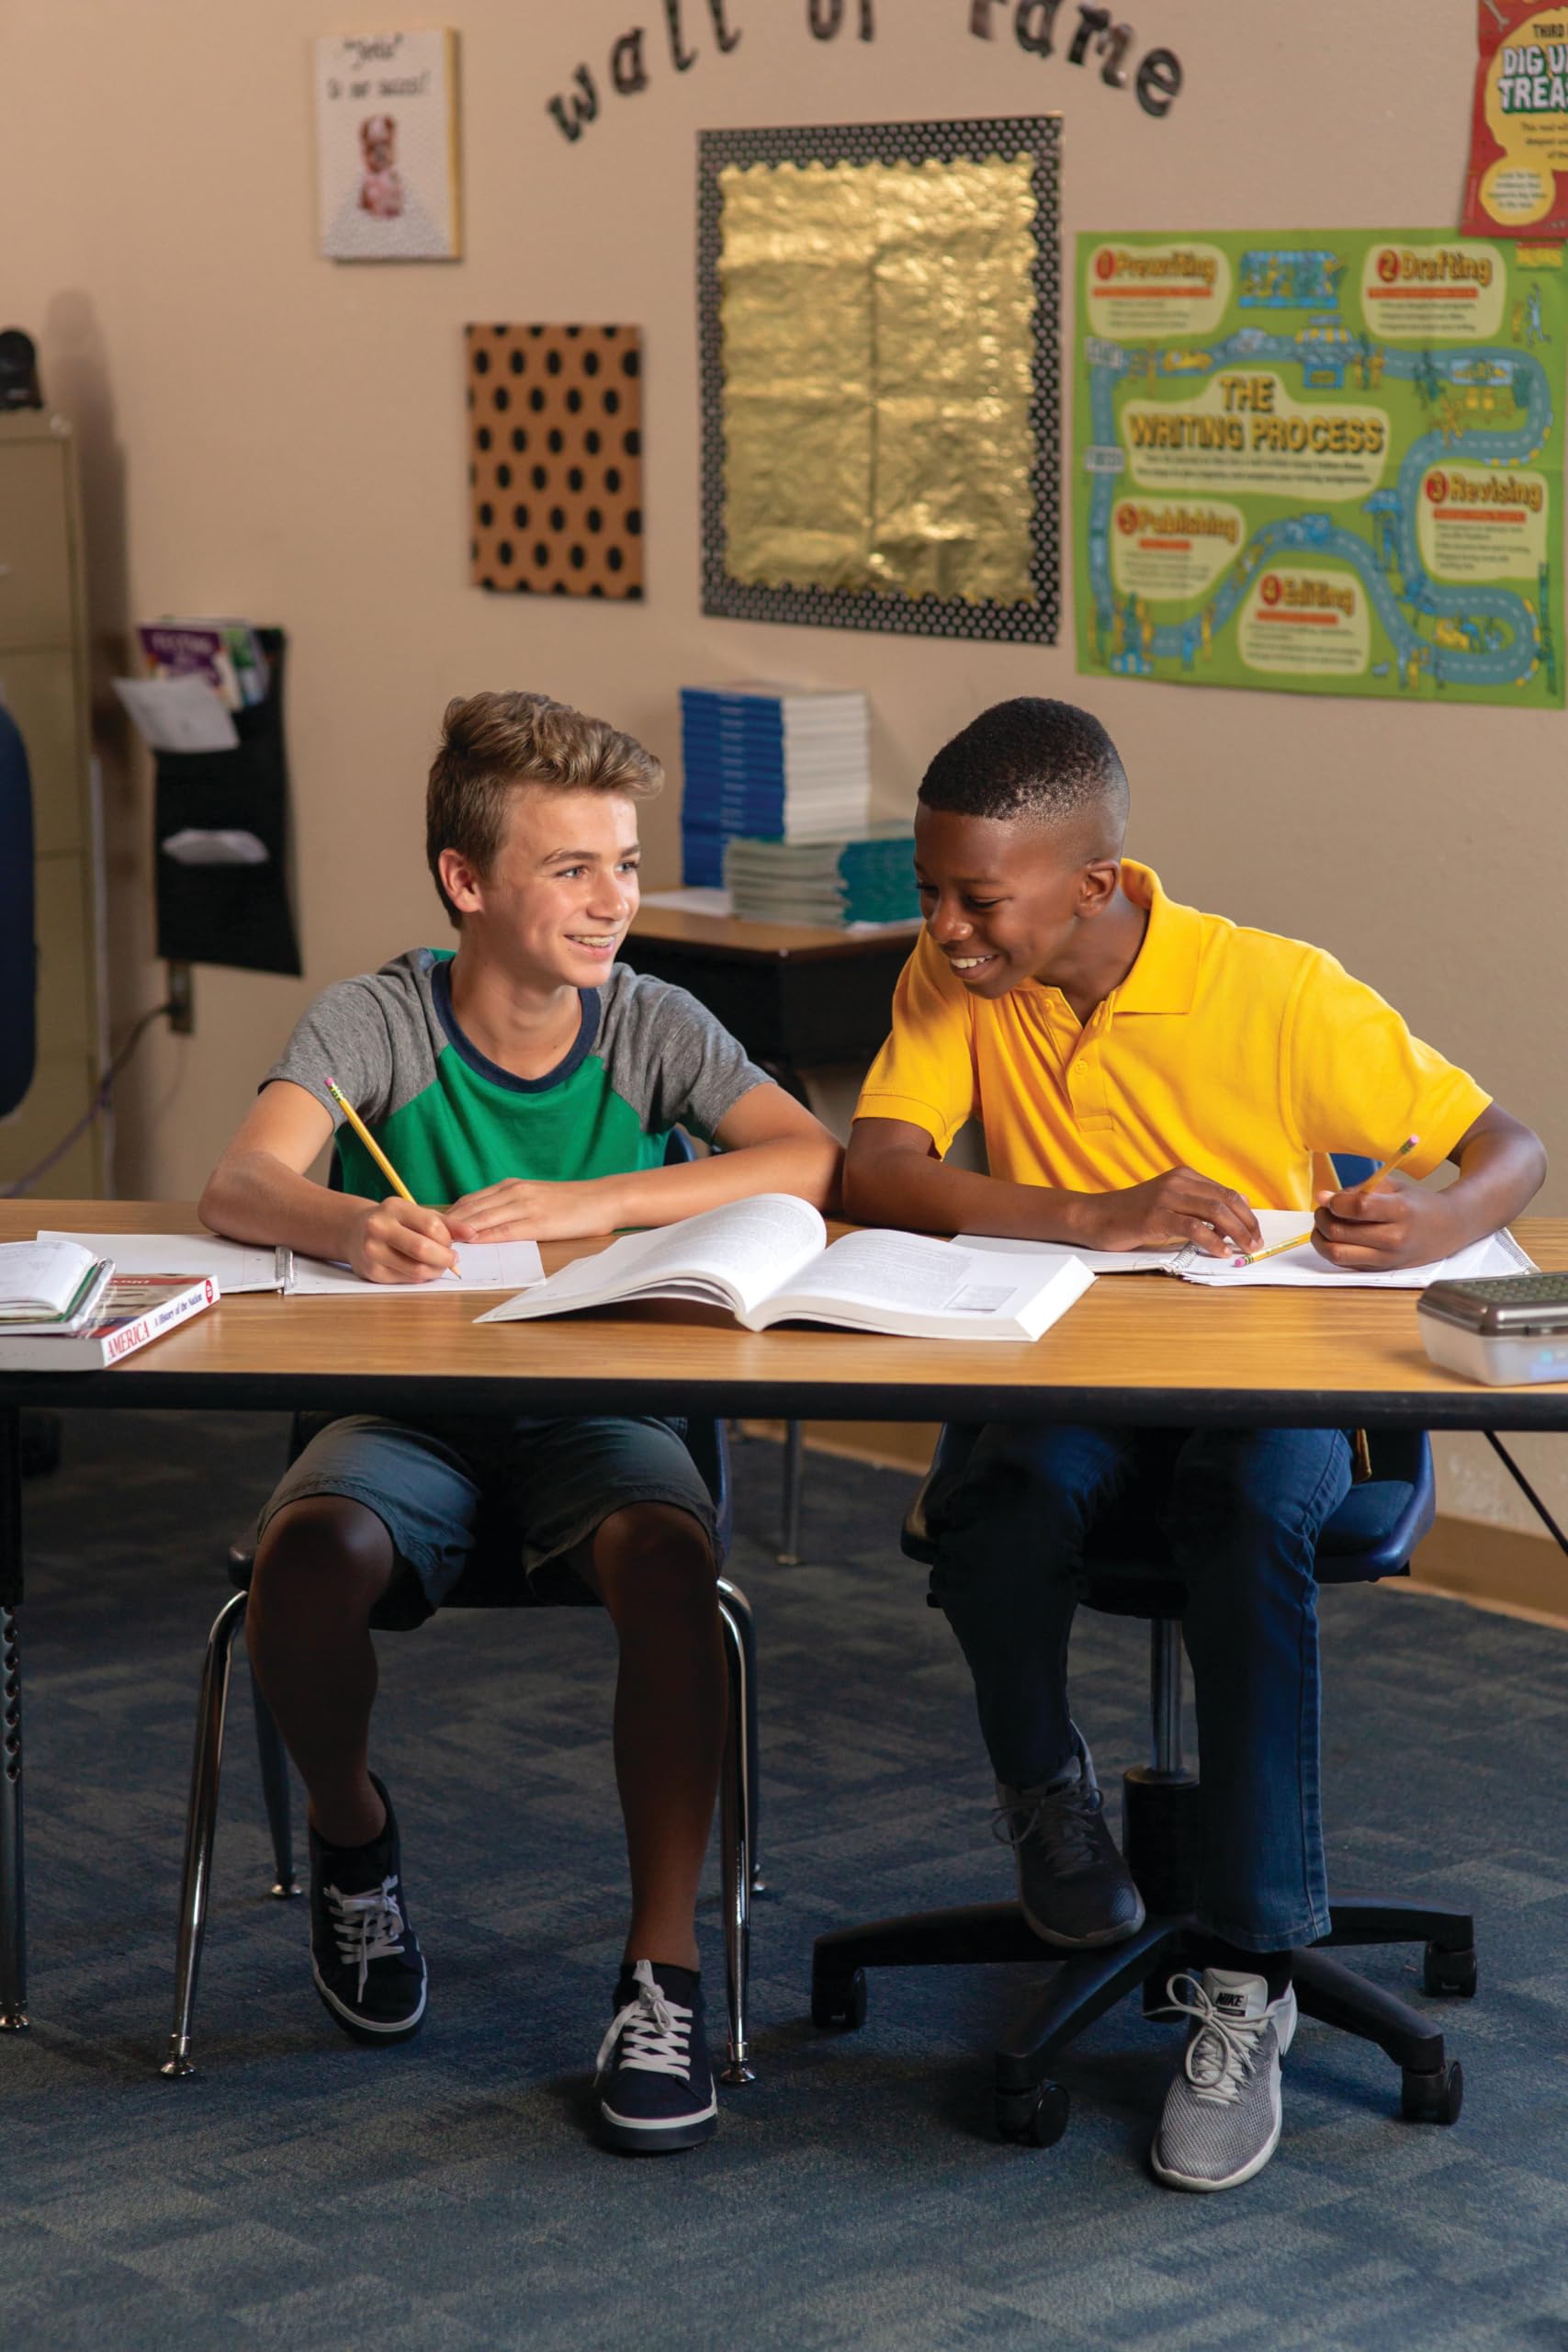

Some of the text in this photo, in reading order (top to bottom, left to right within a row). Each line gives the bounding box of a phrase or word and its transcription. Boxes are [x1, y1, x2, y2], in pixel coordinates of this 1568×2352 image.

[1533, 24, 1564, 39] THIRD
[546, 0, 741, 142] wall
[1503, 44, 1568, 76] DIG U
[1498, 75, 1568, 112] TREA
[1401, 250, 1493, 287] Drafting
[1219, 376, 1276, 413] THE
[1128, 413, 1384, 455] WRITING PROCESS
[1450, 471, 1542, 512] Revising
[107, 1320, 150, 1358] AMERICA
[1215, 1992, 1244, 2007] NIKE
